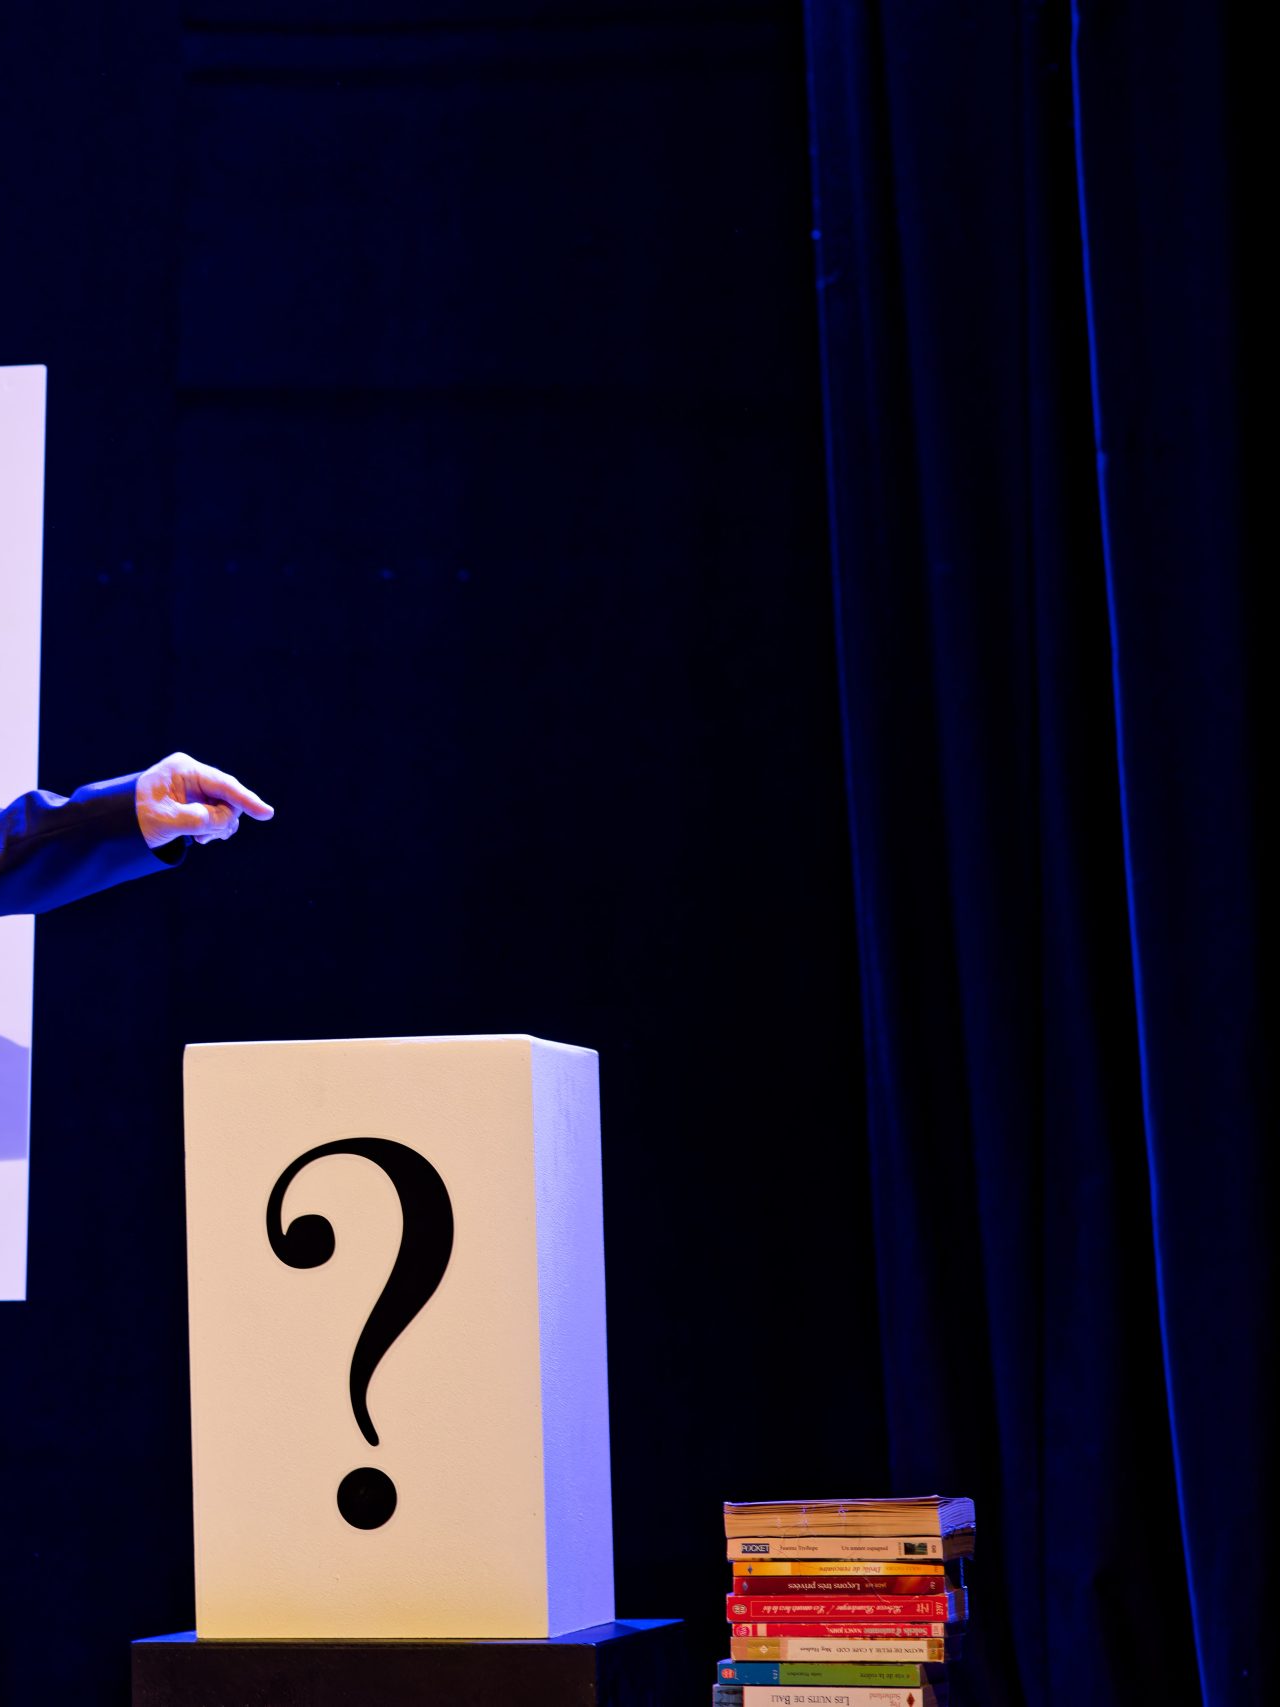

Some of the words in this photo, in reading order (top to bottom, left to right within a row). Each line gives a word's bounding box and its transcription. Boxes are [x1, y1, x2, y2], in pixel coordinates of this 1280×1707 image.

[741, 1544, 769, 1553] POCKET
[787, 1581, 816, 1591] privées
[817, 1582, 832, 1591] très
[833, 1582, 861, 1591] Leçons
[794, 1695, 805, 1703] DE
[808, 1695, 832, 1704] NUITS
[834, 1695, 850, 1706] LES
